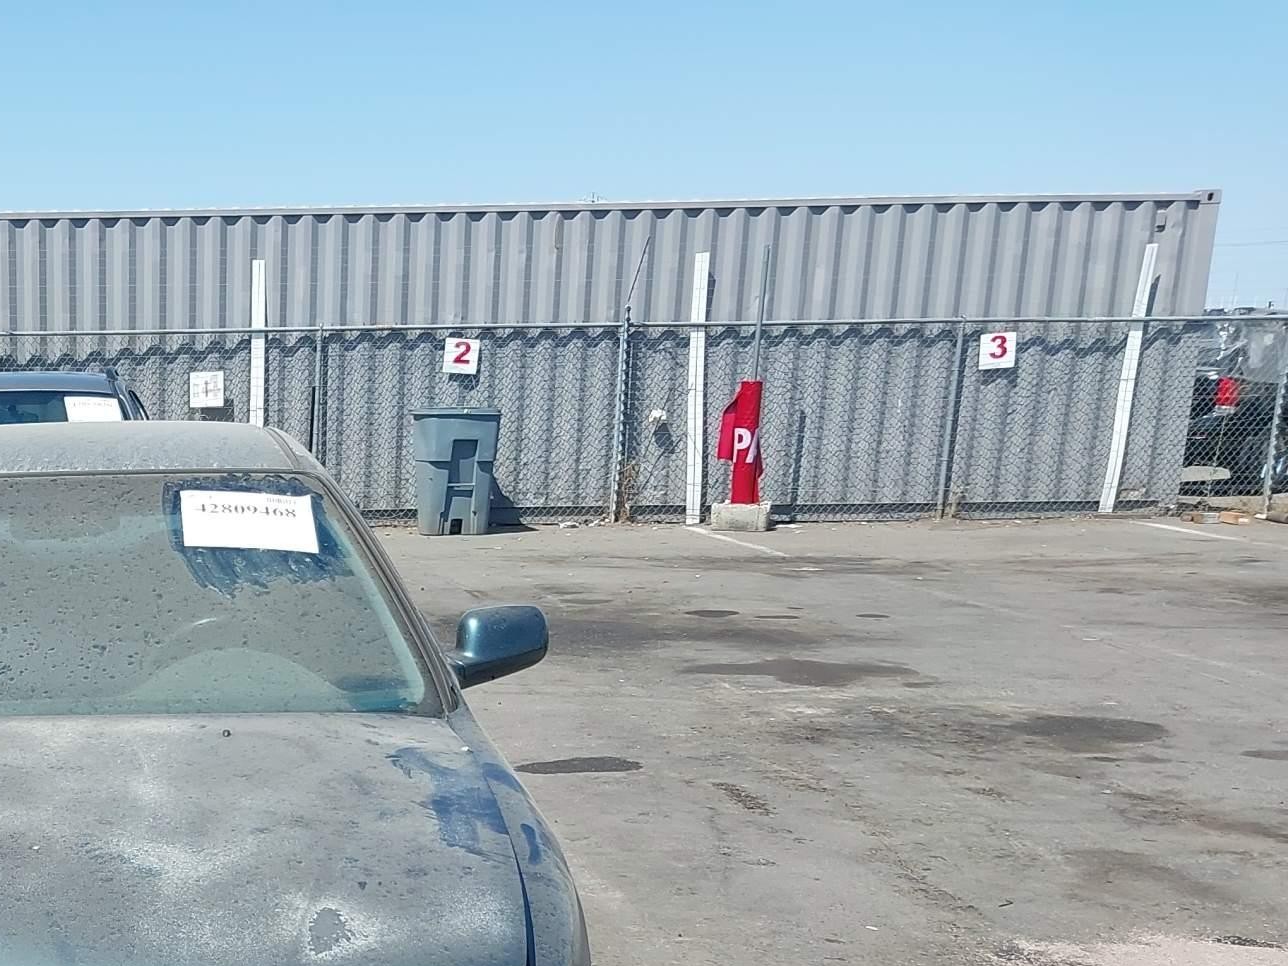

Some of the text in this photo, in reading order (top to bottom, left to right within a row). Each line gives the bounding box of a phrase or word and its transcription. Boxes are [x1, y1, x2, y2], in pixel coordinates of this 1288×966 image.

[452, 341, 472, 365] 2
[988, 335, 1008, 359] 3
[195, 503, 297, 518] 42809468
